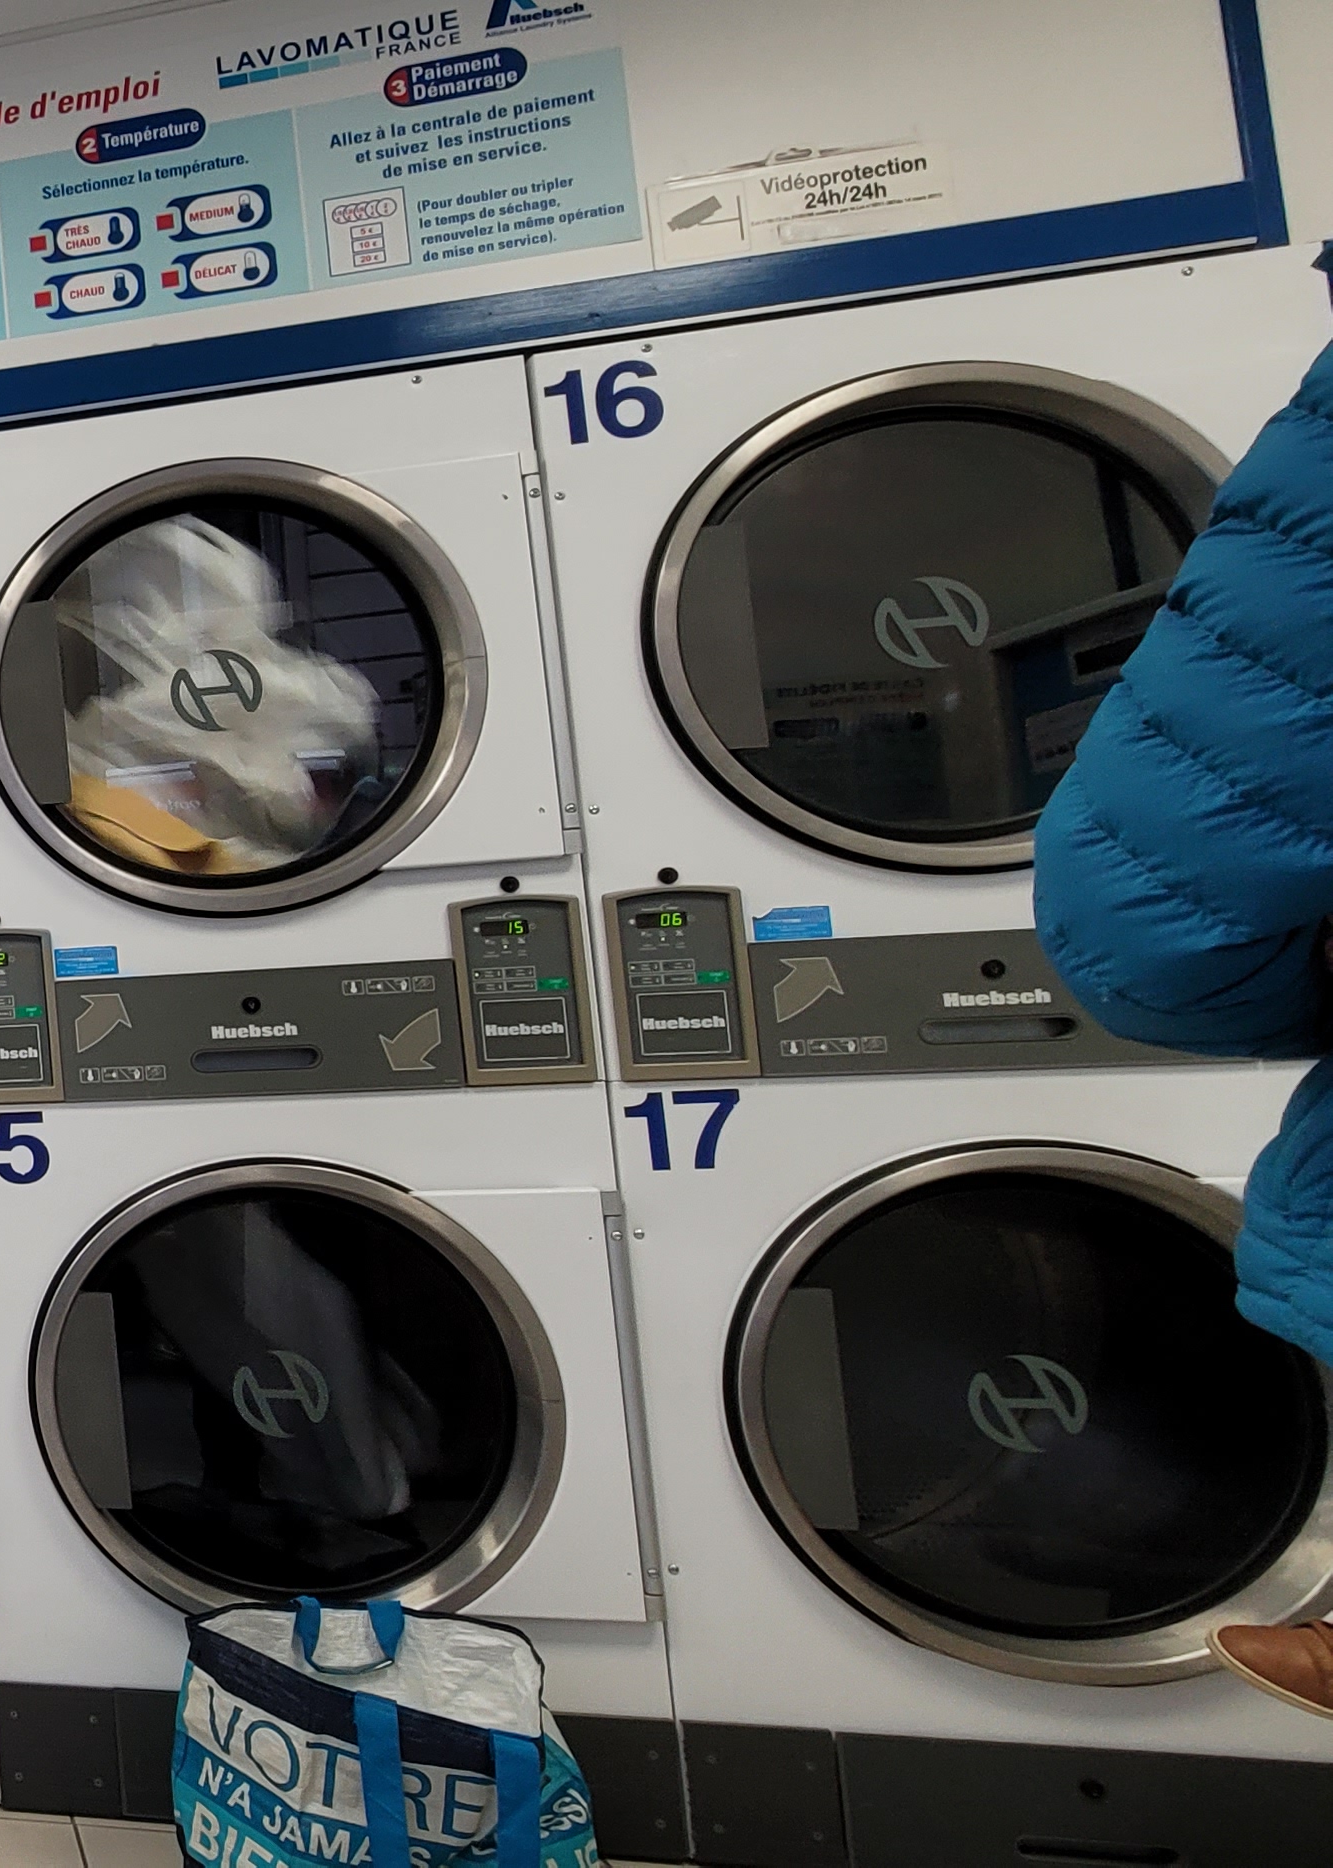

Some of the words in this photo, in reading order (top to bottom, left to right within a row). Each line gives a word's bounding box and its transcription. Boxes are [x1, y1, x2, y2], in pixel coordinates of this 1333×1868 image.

[510, 2, 584, 25] Huebsch
[216, 9, 461, 76] LAVOMATIQUE
[376, 31, 462, 59] FRANCE
[391, 80, 407, 96] 3
[411, 53, 501, 84] Paiement
[413, 70, 518, 100] Démarrage
[30, 71, 161, 119] d'emploi
[330, 131, 372, 149] Allez
[377, 125, 387, 140] à
[390, 121, 407, 137] la
[411, 110, 482, 135] centrale
[487, 104, 507, 120] de
[513, 88, 595, 118] paiement
[82, 138, 97, 154] 2
[102, 120, 200, 150] Température
[382, 164, 403, 179] de
[407, 156, 447, 175] mise
[453, 153, 473, 167] en
[478, 140, 547, 163] service.
[42, 172, 135, 200] Sélectionnez
[138, 169, 152, 182] la
[155, 153, 250, 180] température.
[760, 156, 927, 195] Vidéoprotection
[804, 183, 887, 209] 24h/24h
[189, 205, 234, 222] MEDIUM
[65, 225, 90, 237] TRÈS
[66, 236, 101, 250] CHAUD
[194, 263, 237, 280] DÉLICAT
[69, 285, 105, 300] CHAUD
[544, 361, 666, 445] 16
[508, 921, 524, 934] 15
[660, 913, 683, 927] 06
[943, 987, 1052, 1008] Huebsch
[211, 1022, 299, 1041] Huebsch
[485, 1022, 564, 1037] Huebsch
[642, 1016, 726, 1031] Huebsch
[624, 1088, 740, 1171] 17
